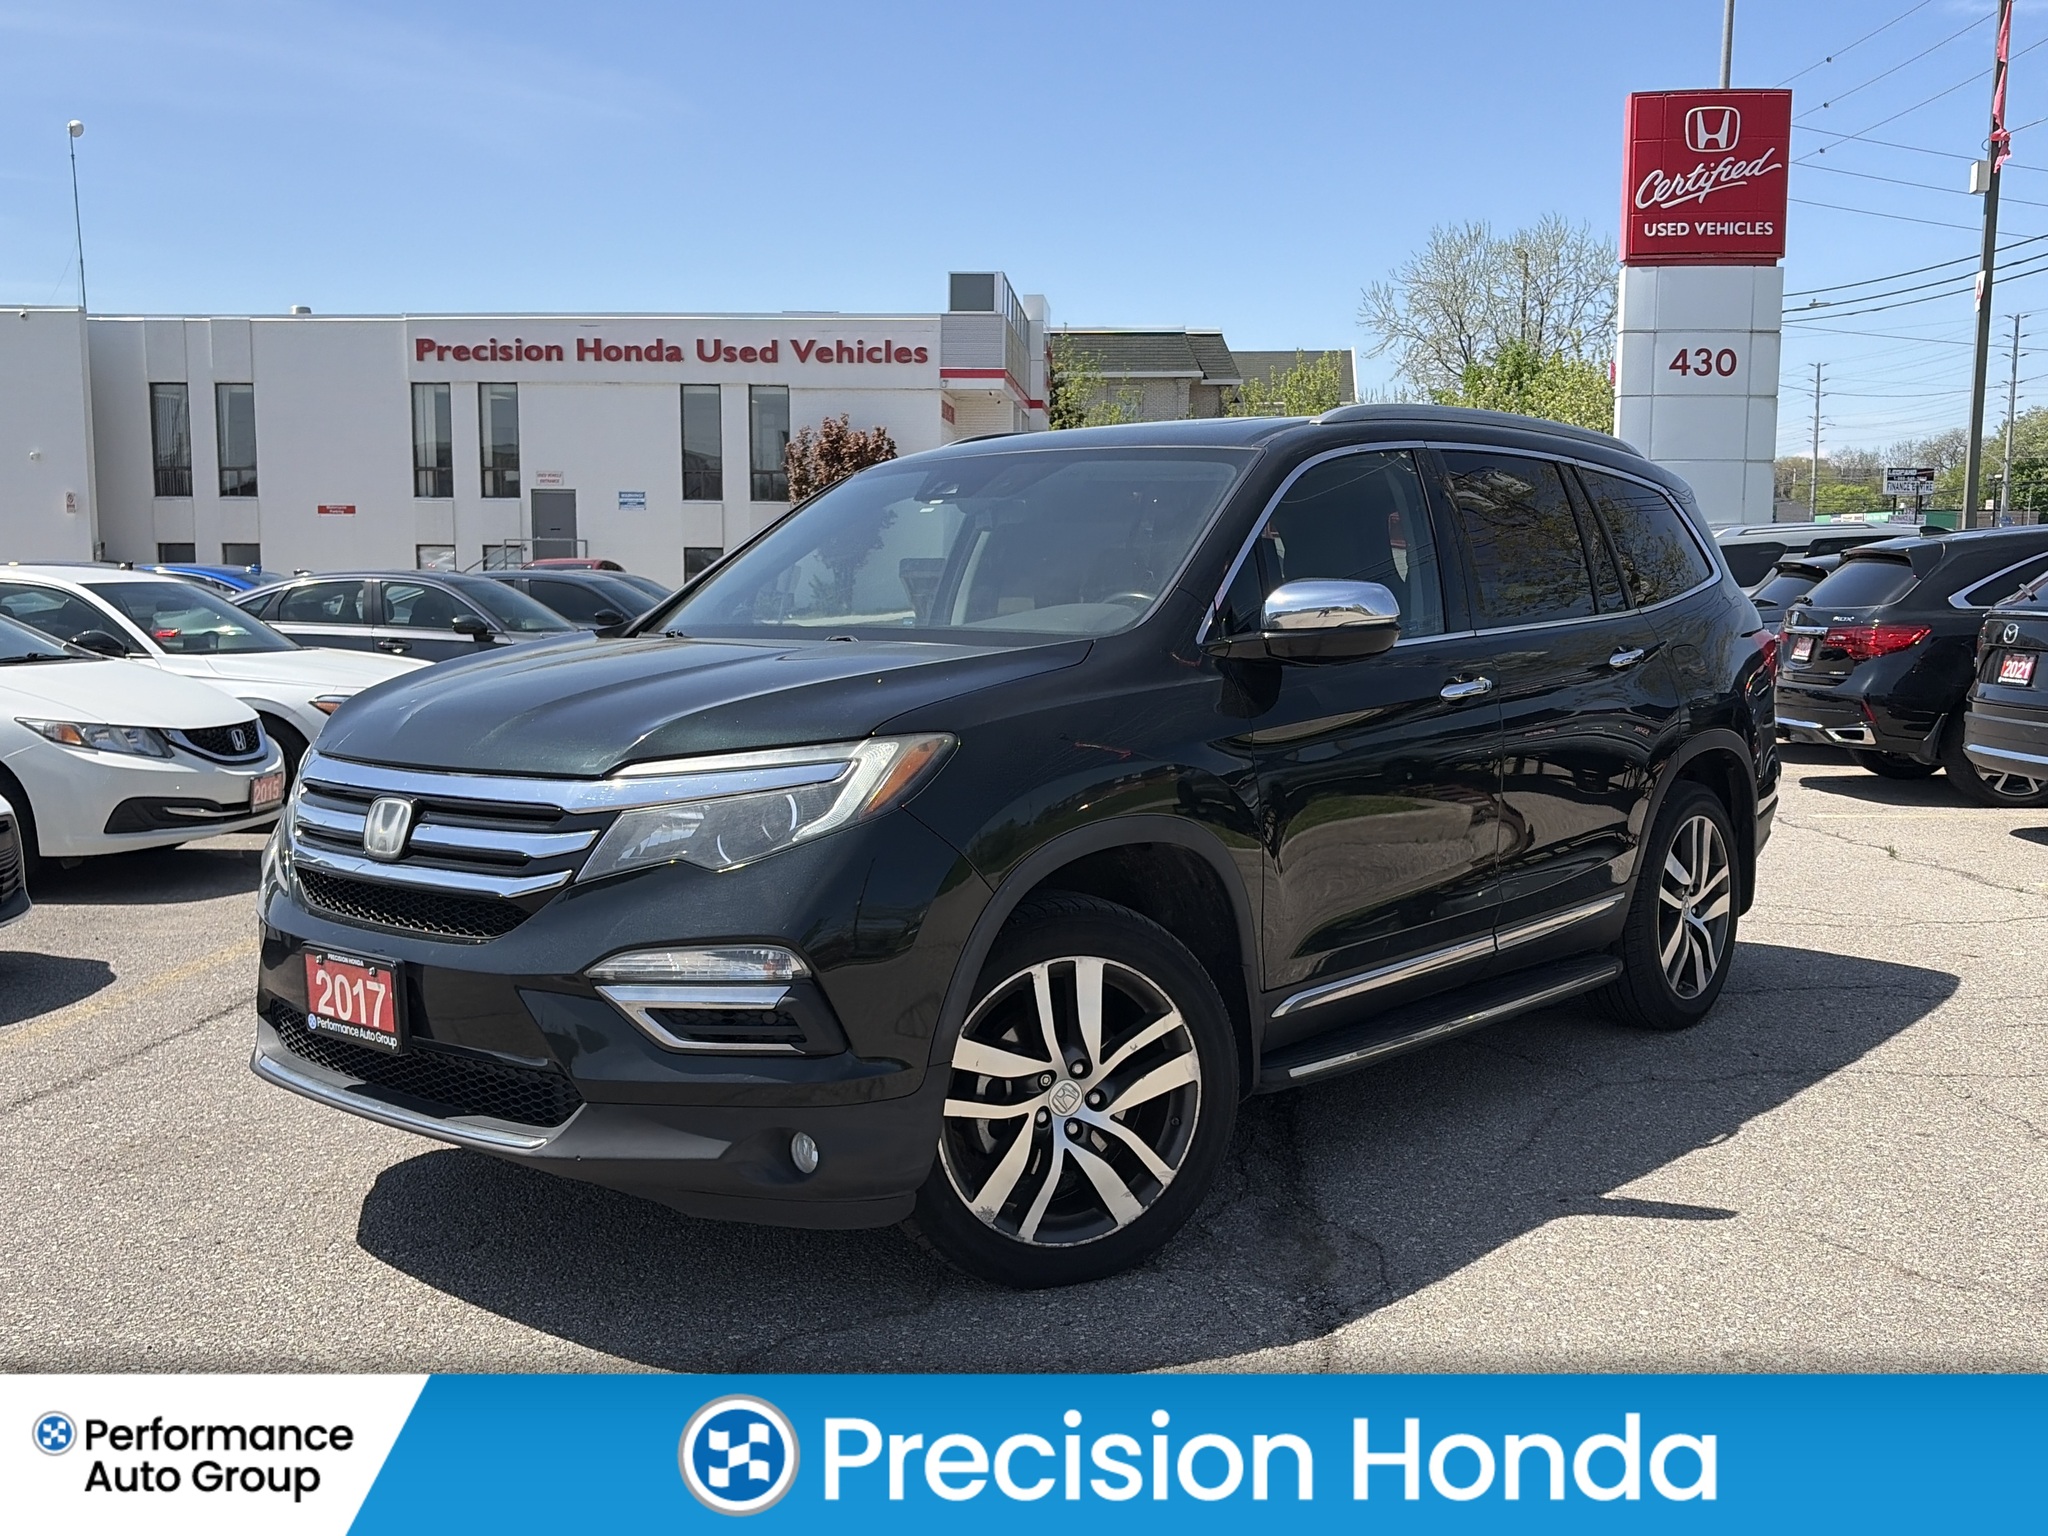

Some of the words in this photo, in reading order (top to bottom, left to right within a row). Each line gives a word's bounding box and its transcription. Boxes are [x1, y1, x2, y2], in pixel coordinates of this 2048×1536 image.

[1635, 147, 1783, 209] Certified
[1644, 222, 1690, 237] USED
[1694, 221, 1774, 236] VEHICLES
[415, 337, 564, 362] Precision
[577, 338, 683, 362] Honda
[696, 338, 779, 363] Used
[790, 338, 929, 364] Vehicles
[1668, 347, 1737, 377] 430
[1887, 481, 1910, 491] FINANCE
[2003, 660, 2033, 679] 2021
[255, 780, 279, 804] 2015
[327, 953, 348, 964] PRECISION
[315, 969, 386, 1028] 2017
[318, 1017, 359, 1037] Performance
[360, 1028, 375, 1041] Auto
[375, 1031, 398, 1050] Group
